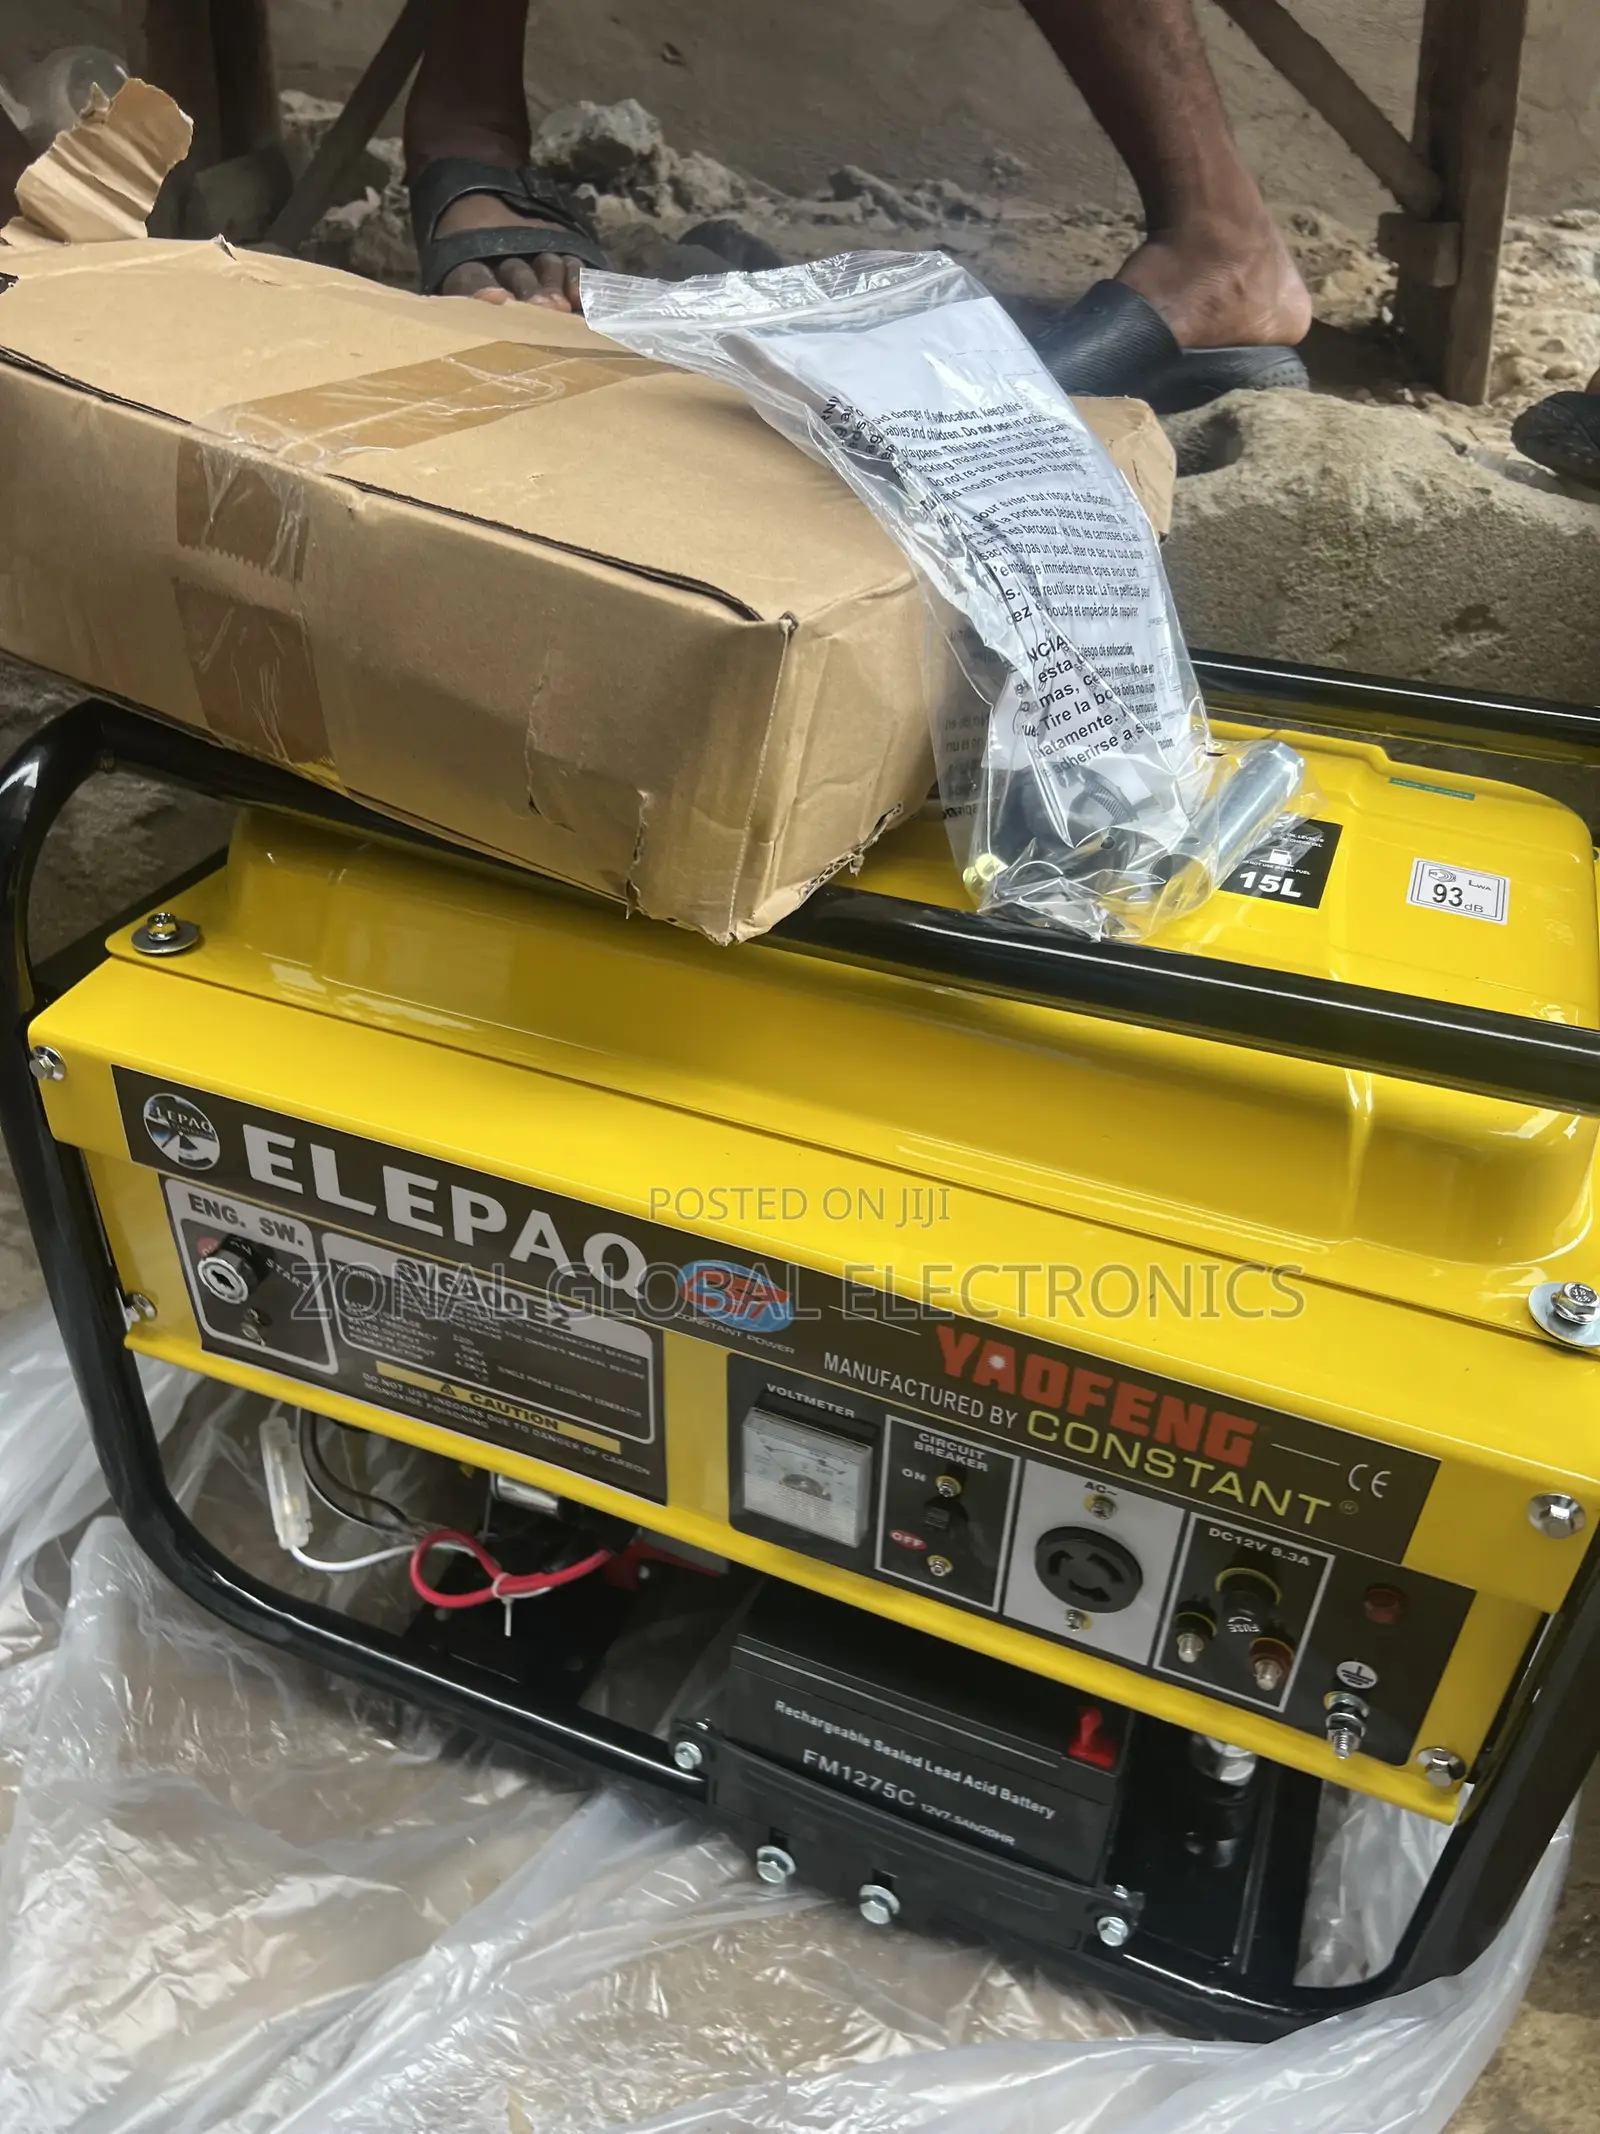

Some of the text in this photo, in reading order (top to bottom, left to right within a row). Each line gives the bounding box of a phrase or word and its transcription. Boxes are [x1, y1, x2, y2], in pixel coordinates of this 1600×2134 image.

[980, 404, 1004, 418] keep
[1003, 401, 1023, 412] this
[910, 425, 925, 439] and
[960, 426, 979, 437] Do
[979, 423, 997, 434] not
[996, 421, 1013, 431] use
[942, 441, 967, 454] This
[965, 438, 990, 452] bag
[996, 438, 1054, 456] immediately
[940, 488, 962, 502] and
[960, 477, 996, 494] mouth
[994, 470, 1017, 483] and
[1014, 462, 1052, 479] prevent
[944, 471, 965, 486] not
[962, 463, 997, 477] re-use
[993, 457, 1016, 470] this
[972, 502, 1000, 523] pour
[1026, 491, 1047, 502] tout
[979, 548, 1002, 562] sac
[1038, 659, 1074, 684] esta
[1039, 699, 1092, 732] Tire la
[1052, 736, 1119, 775] adherirse
[1239, 870, 1303, 899] 15L
[1432, 883, 1485, 914] 93 dB
[187, 1192, 304, 1247] ENG. SW.
[242, 1123, 648, 1300] ELEPAQ
[264, 1256, 311, 1293] START
[674, 1312, 796, 1355] CONSTANT POWER
[364, 1383, 424, 1409] MONOXIDE
[469, 1392, 559, 1431] CAUTION
[766, 1383, 857, 1420] VOLTMETER
[936, 1324, 1261, 1470] YAOFENG
[362, 1372, 379, 1385] DO
[381, 1377, 405, 1392] NOT
[406, 1385, 430, 1400] USE
[432, 1394, 486, 1419] INDOORS
[486, 1413, 510, 1429] DUE
[513, 1420, 530, 1434] TO
[532, 1428, 581, 1452] DANGER
[601, 1453, 651, 1476] CARBON
[823, 1350, 1332, 1527] MANUFACTURED BY CONSTANT
[914, 1440, 990, 1473] BREAKER
[917, 1432, 987, 1460] CIRCUIT
[901, 1467, 927, 1483] ON
[1347, 1463, 1393, 1500] CE
[891, 1531, 924, 1550] OFF
[1208, 1527, 1312, 1568] DC12V 8.3A
[1228, 1622, 1260, 1634] FUSE
[774, 1699, 1057, 1820] Rechargeable Sealed Lead Acid Battery
[802, 1748, 917, 1808] FM1275C
